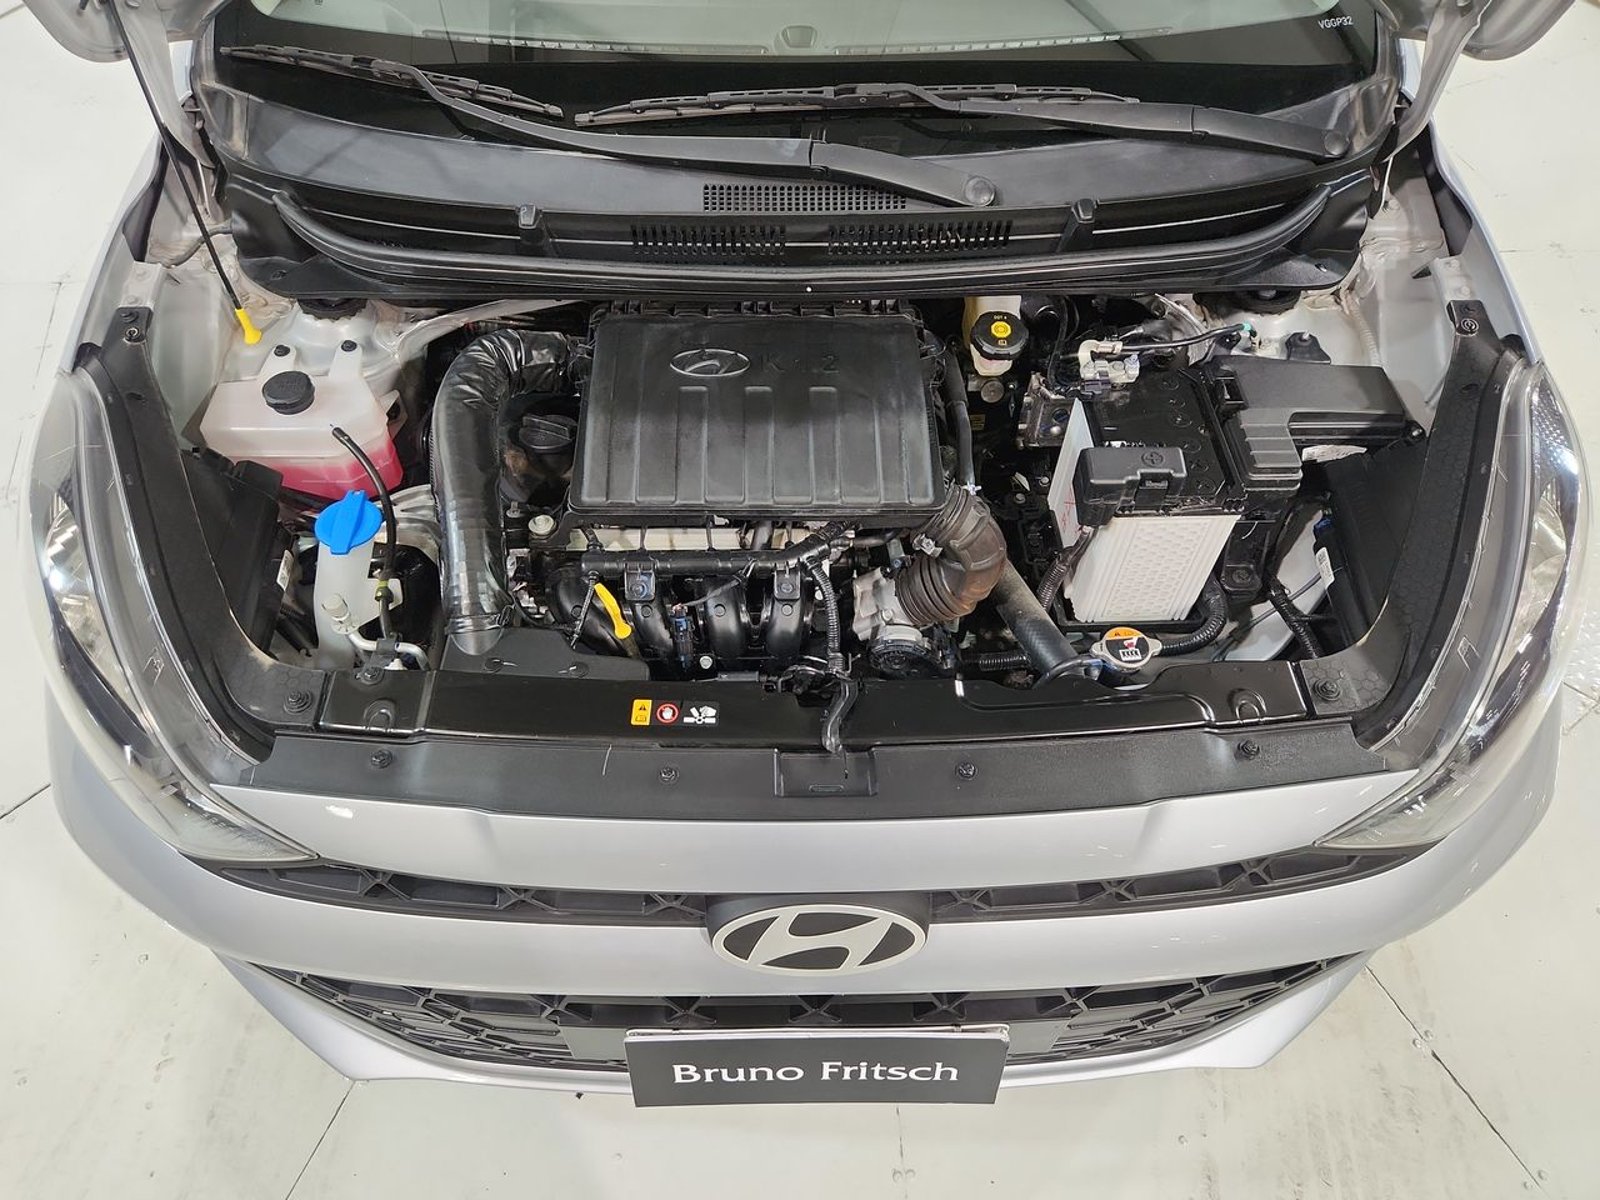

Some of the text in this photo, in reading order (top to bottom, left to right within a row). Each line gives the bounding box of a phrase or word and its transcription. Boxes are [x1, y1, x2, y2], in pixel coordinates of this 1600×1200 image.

[1318, 16, 1354, 29] VGGP32
[672, 1061, 959, 1084] Bruno Fritsch
